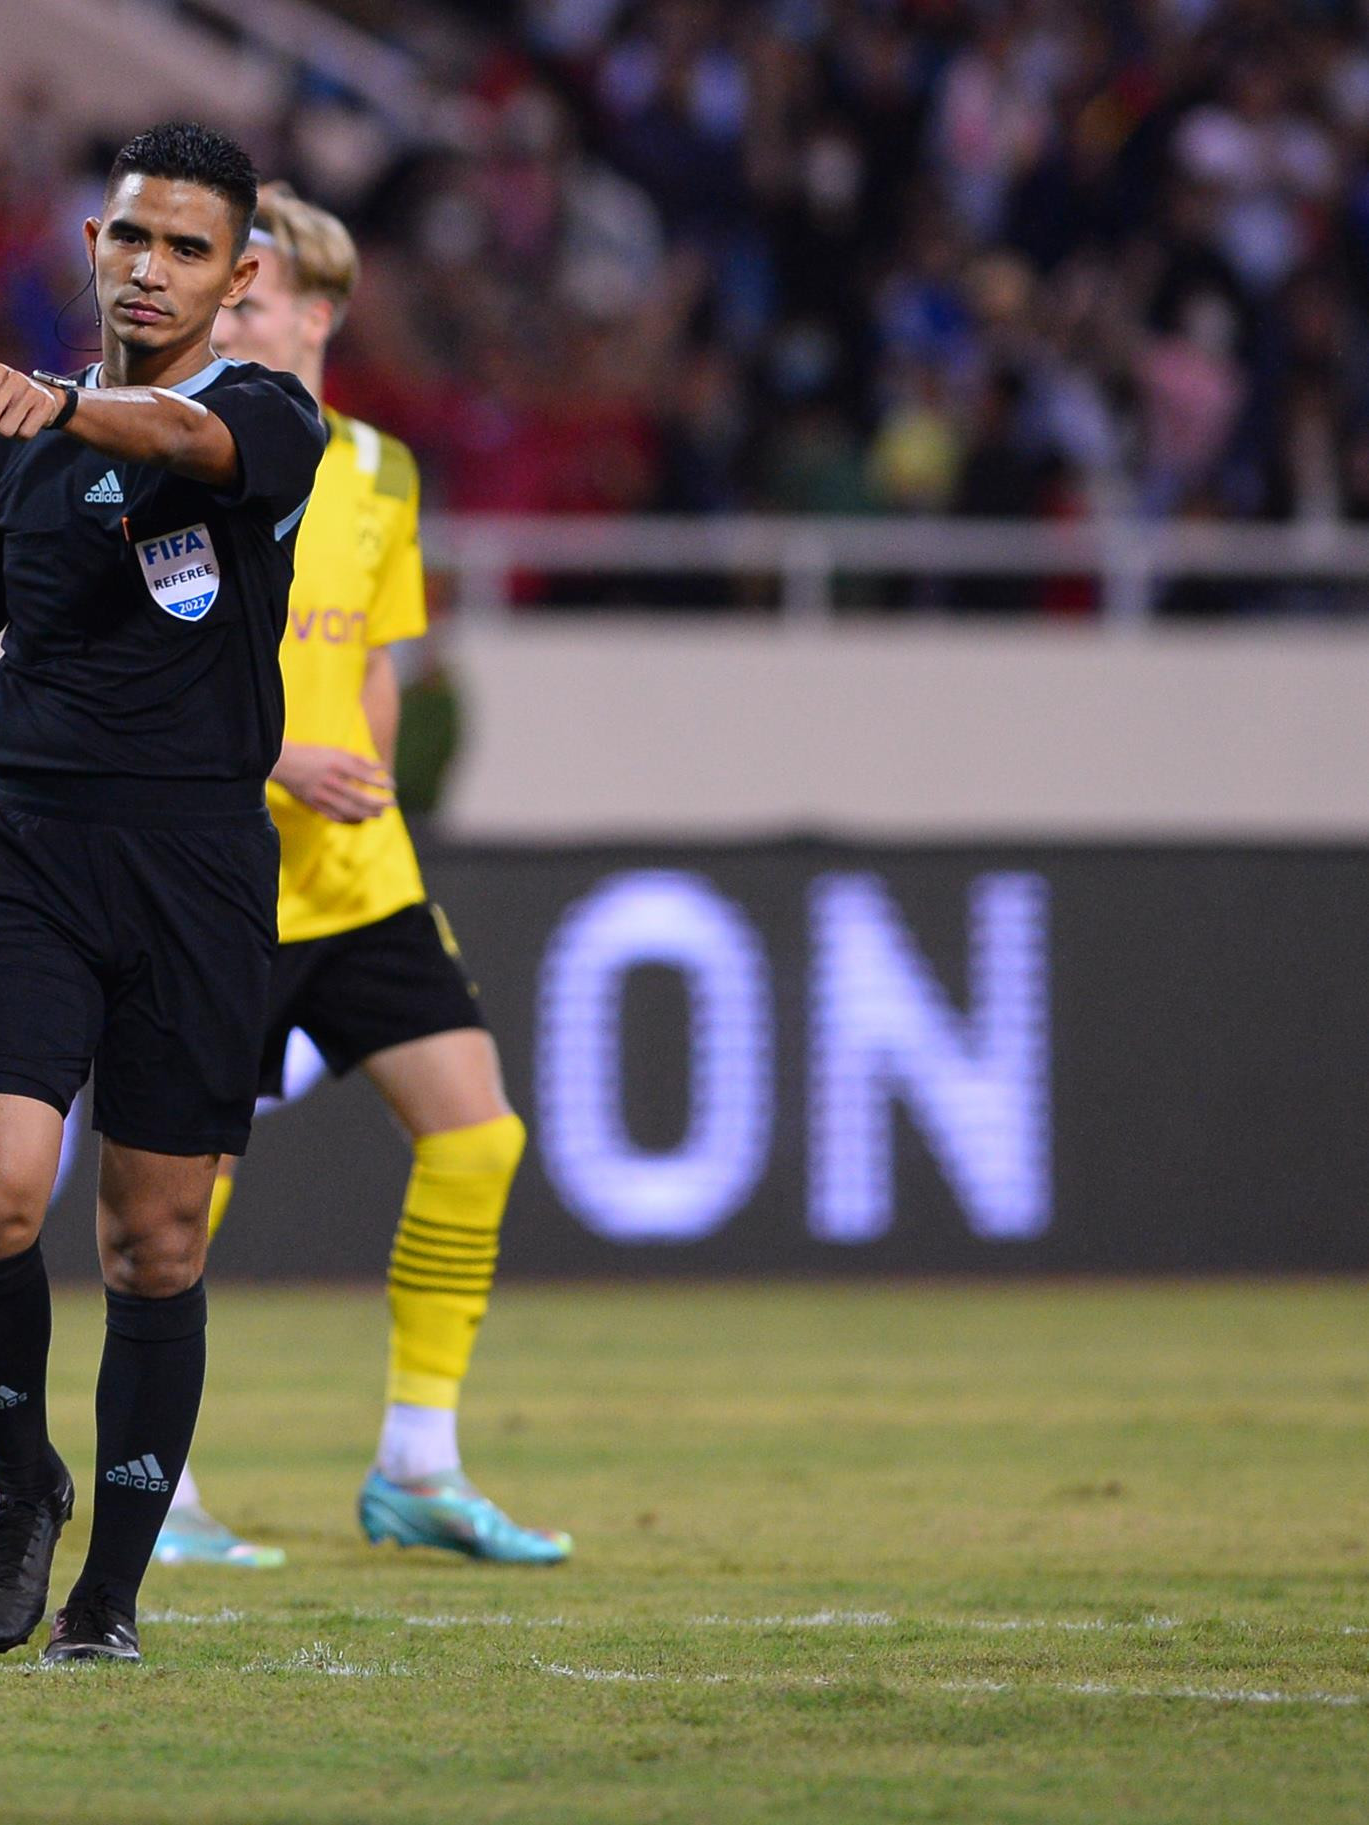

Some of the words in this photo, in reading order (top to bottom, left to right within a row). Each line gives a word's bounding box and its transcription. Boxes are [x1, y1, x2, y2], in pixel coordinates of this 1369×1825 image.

[142, 531, 206, 566] FIFA
[154, 563, 213, 591] REFEREE
[178, 597, 206, 614] 2022
[534, 867, 1053, 1244] ON
[106, 1470, 169, 1492] adidas
